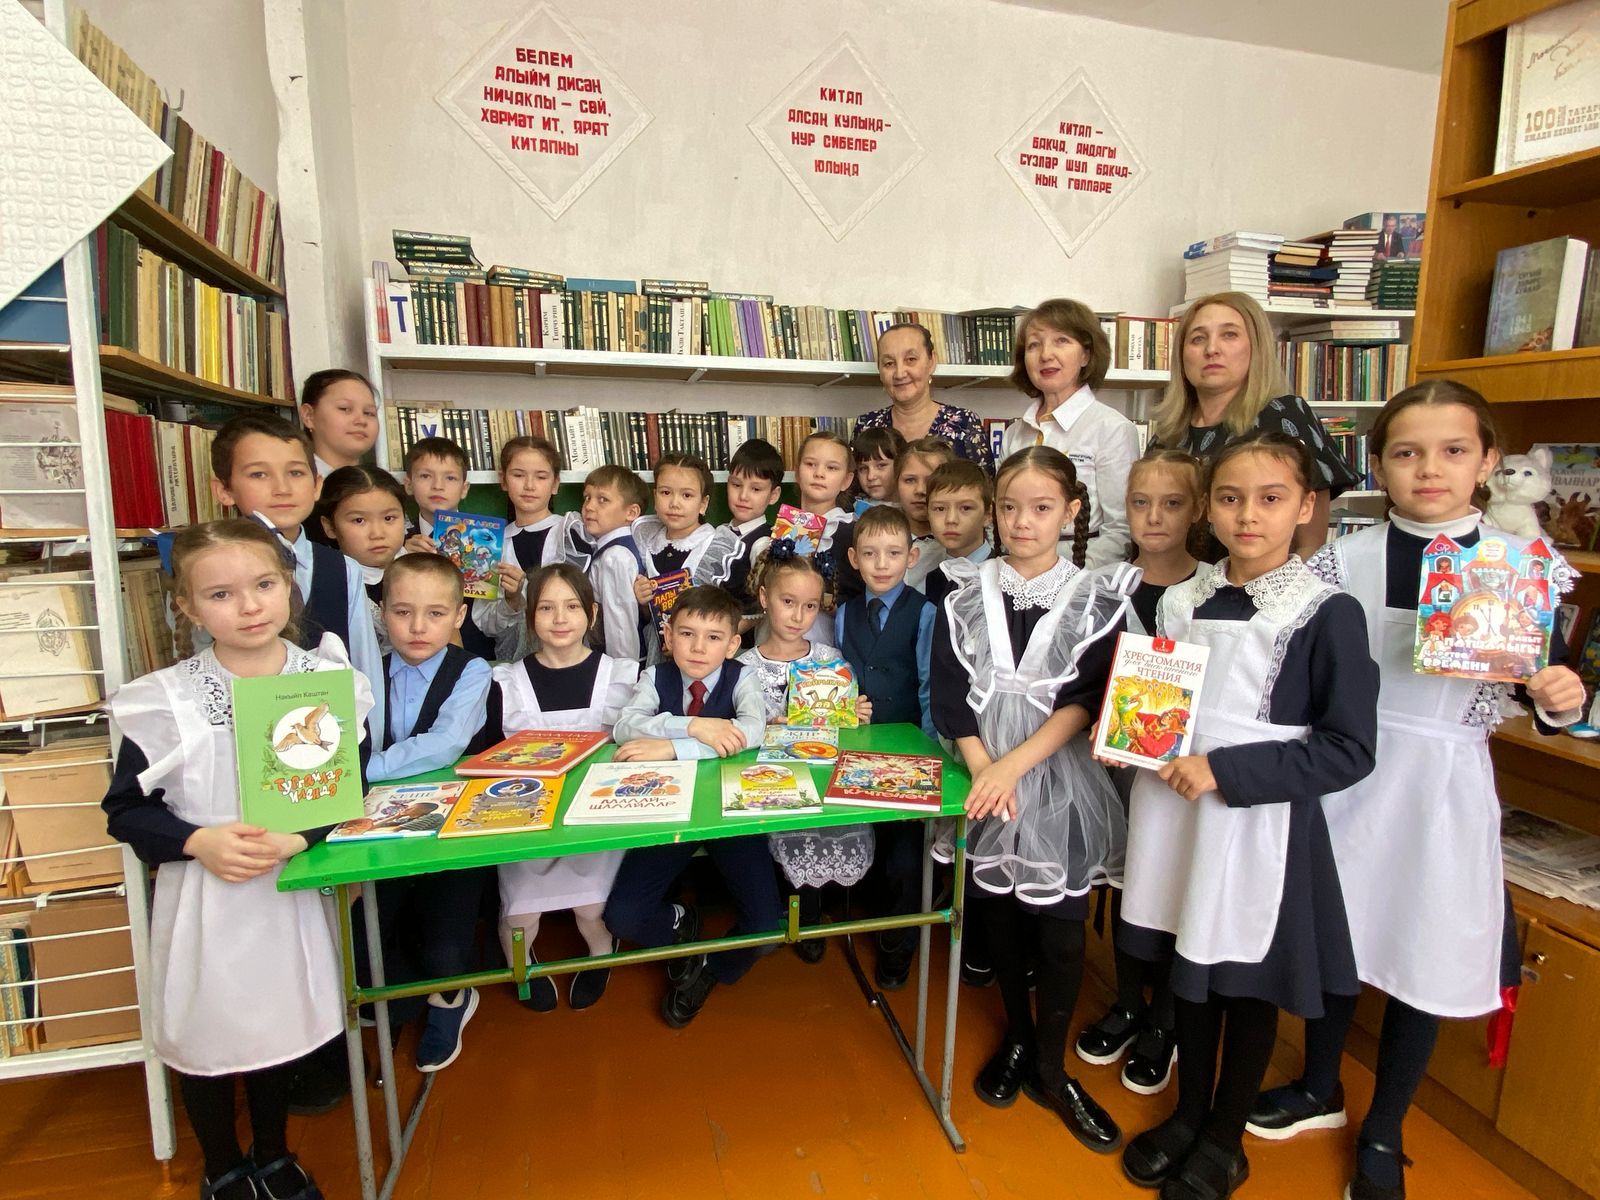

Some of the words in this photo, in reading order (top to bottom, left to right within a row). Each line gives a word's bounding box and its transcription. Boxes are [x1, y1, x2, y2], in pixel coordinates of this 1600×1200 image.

[515, 47, 573, 68] БЕЛЕМ
[494, 66, 550, 88] АЛЫЙМ
[483, 86, 556, 111] НИЧАКЛЫ
[820, 87, 863, 106] КИТАП
[480, 107, 534, 129] ХӨРМӘТ
[573, 120, 609, 136] ЯРАТ
[788, 109, 829, 128] АЛСАҢ
[1525, 108, 1556, 133] 100
[1059, 121, 1092, 138] КИТАП
[511, 135, 579, 156] КИТАПНЫ
[791, 131, 816, 147] НУР
[822, 135, 877, 153] СИБЕЛЕР
[1076, 142, 1117, 160] АНДАГЫ
[814, 159, 859, 177] ЮЛЫҢА
[1065, 159, 1088, 174] ШУЛ
[1068, 177, 1112, 194] ГӨЛЛӘРЕ
[389, 296, 408, 332] Т
[654, 589, 676, 606] ЛАПЫ
[1162, 641, 1166, 649] 1
[1123, 650, 1202, 673] ХРЕСТОМАТИЯ
[1138, 667, 1182, 683] ЧТЕНИЯ
